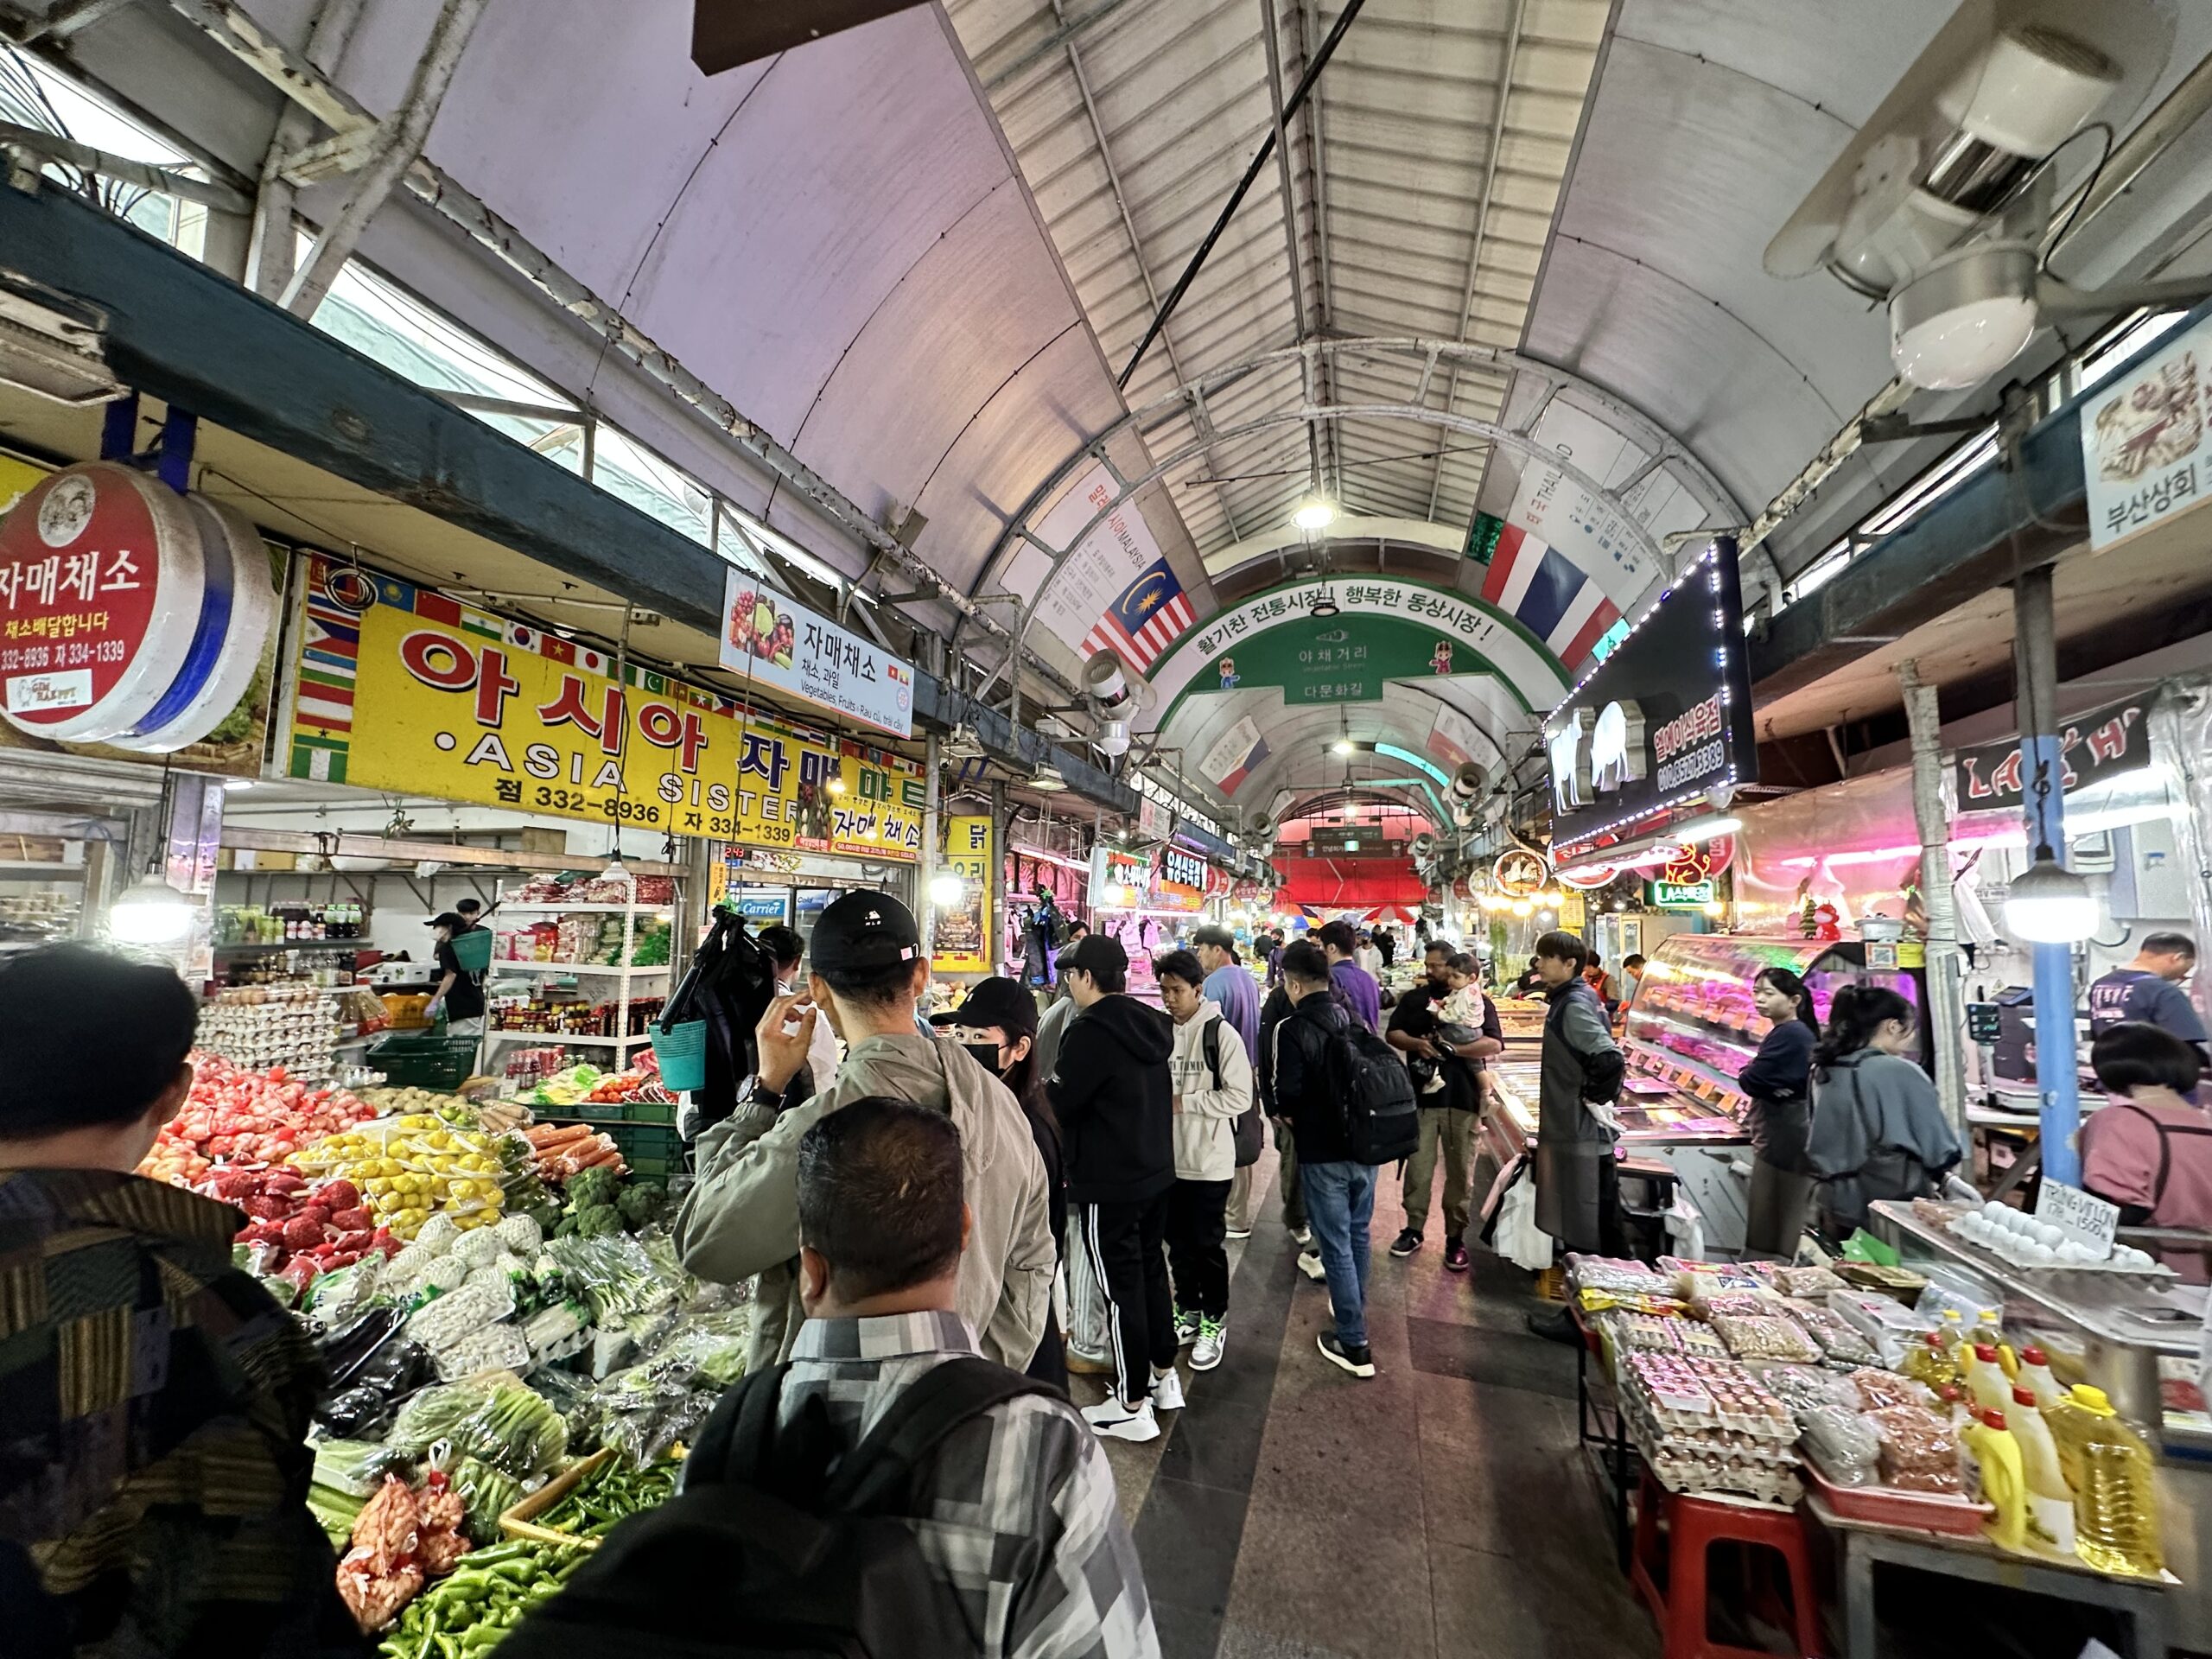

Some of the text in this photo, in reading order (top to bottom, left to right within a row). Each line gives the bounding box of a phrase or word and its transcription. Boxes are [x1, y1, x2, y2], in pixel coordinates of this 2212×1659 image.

[1537, 443, 1573, 506] THAILND
[2106, 463, 2199, 534] 부산상회
[1118, 529, 1147, 571] MALAYSIA
[4, 611, 111, 639] 채소배달합니다
[1196, 616, 1249, 656] 활기찬
[1345, 585, 1402, 607] 행복한
[68, 639, 125, 664] 334-1339
[804, 622, 877, 683] 자매채소
[823, 668, 840, 690] 과일
[1305, 681, 1363, 699] 다문화길
[838, 695, 856, 713] Fruits
[859, 704, 873, 719] Rau
[1654, 692, 1722, 763] 엘에이식육점
[463, 732, 628, 794] ASIA
[494, 778, 791, 843] 점 332-8936 자 334-1339
[884, 814, 918, 846] 채소
[969, 824, 987, 849] 닭
[743, 902, 780, 914] Carrier
